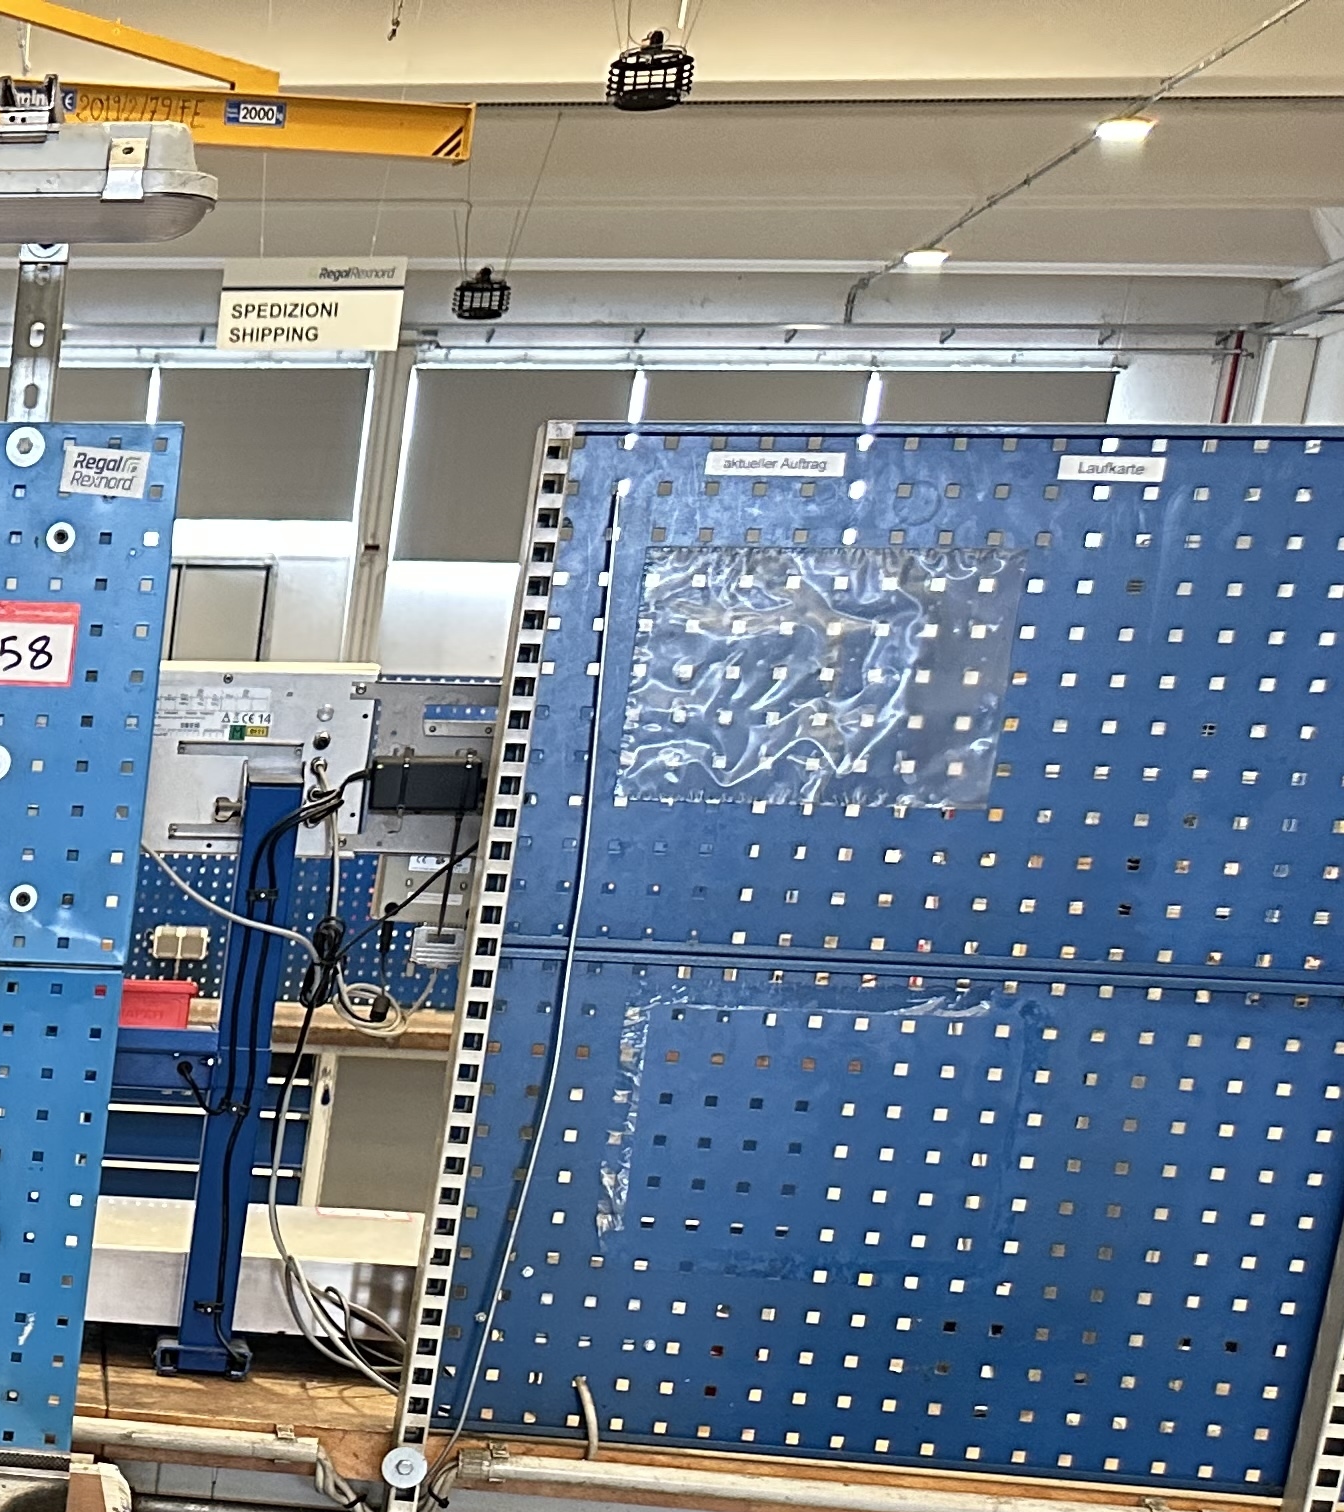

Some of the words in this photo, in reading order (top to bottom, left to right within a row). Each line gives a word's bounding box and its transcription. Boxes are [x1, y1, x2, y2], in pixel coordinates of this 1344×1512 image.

[241, 106, 275, 121] 2000
[231, 302, 339, 319] SPEDIZIONI
[228, 326, 319, 343] SHIPPING
[73, 452, 124, 475] Regal
[723, 458, 778, 469] aktueller
[780, 457, 828, 473] Auftrag
[1077, 461, 1146, 475] Laufkarte
[70, 470, 136, 491] Rexnord
